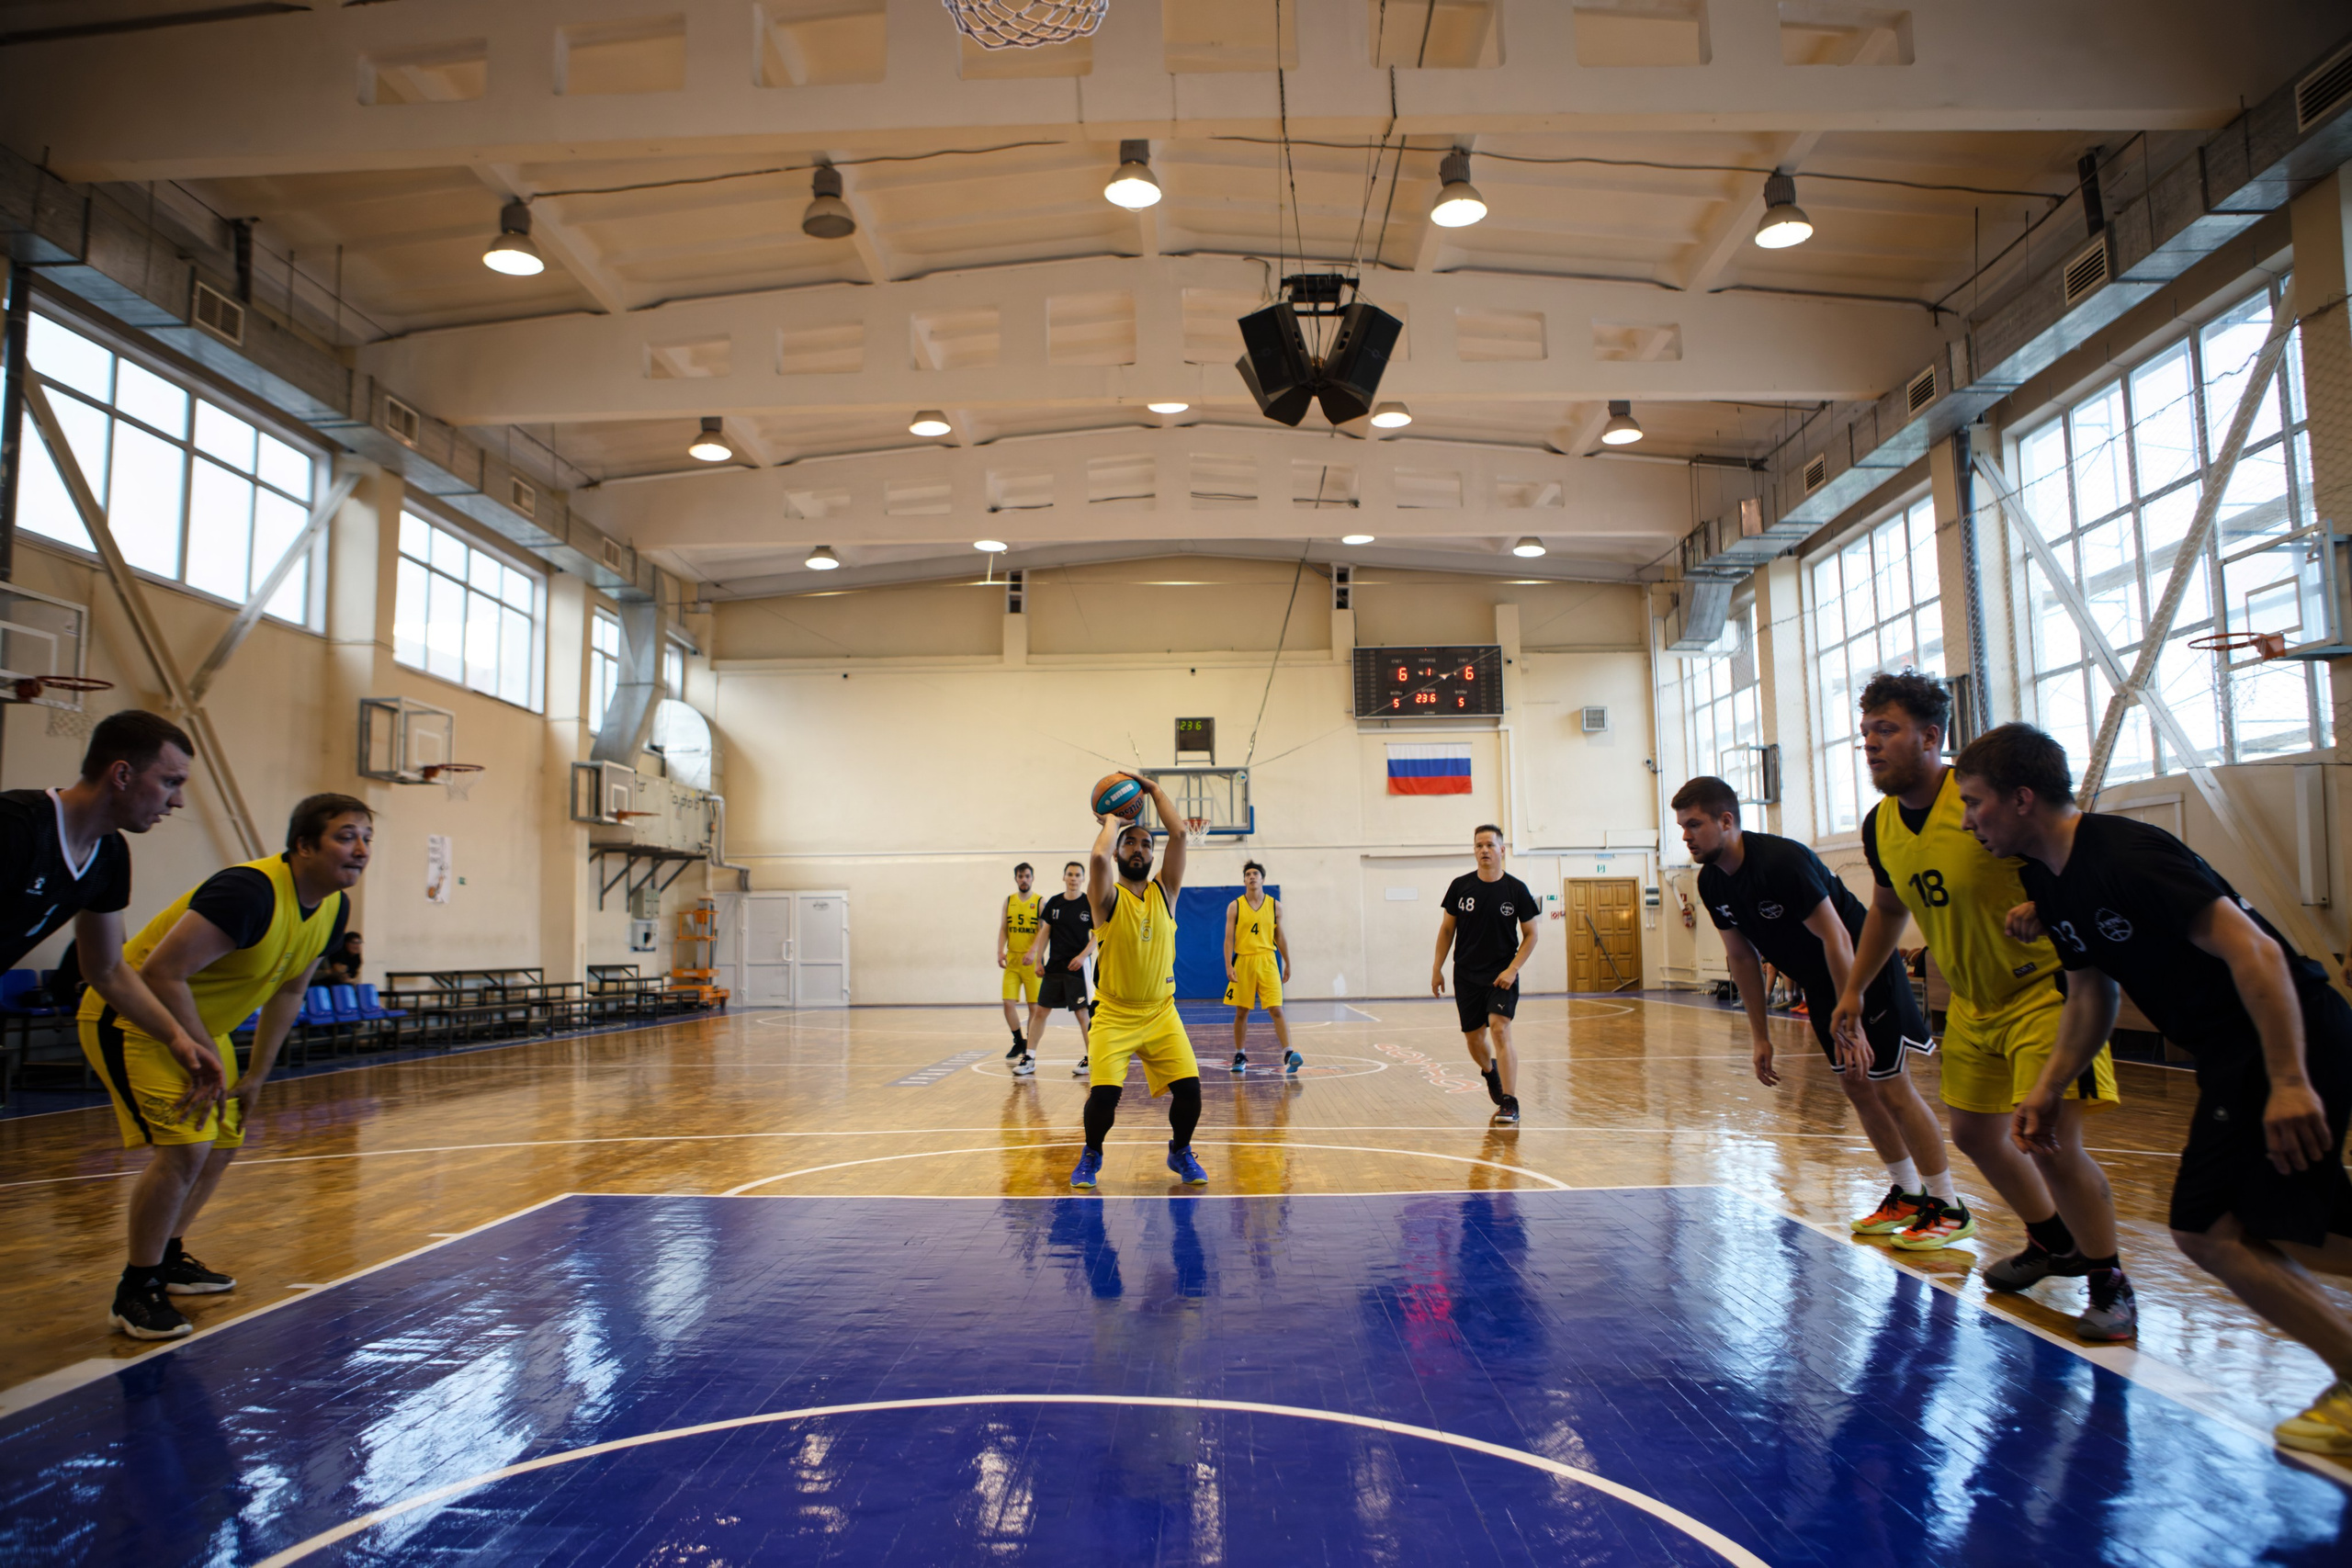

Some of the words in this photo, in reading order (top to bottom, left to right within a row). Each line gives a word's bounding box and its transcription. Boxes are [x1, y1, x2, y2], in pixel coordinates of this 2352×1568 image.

[1397, 666, 1408, 682] 6
[1427, 668, 1431, 676] 1
[1464, 665, 1475, 681] 6
[1393, 698, 1400, 708] 5
[1457, 697, 1464, 707] 5
[1908, 869, 1950, 908] 18
[1457, 897, 1476, 912] 48
[1018, 914, 1024, 925] 5
[1139, 919, 1153, 942] 6
[1250, 922, 1260, 935] 4
[1226, 988, 1234, 1001] 4
